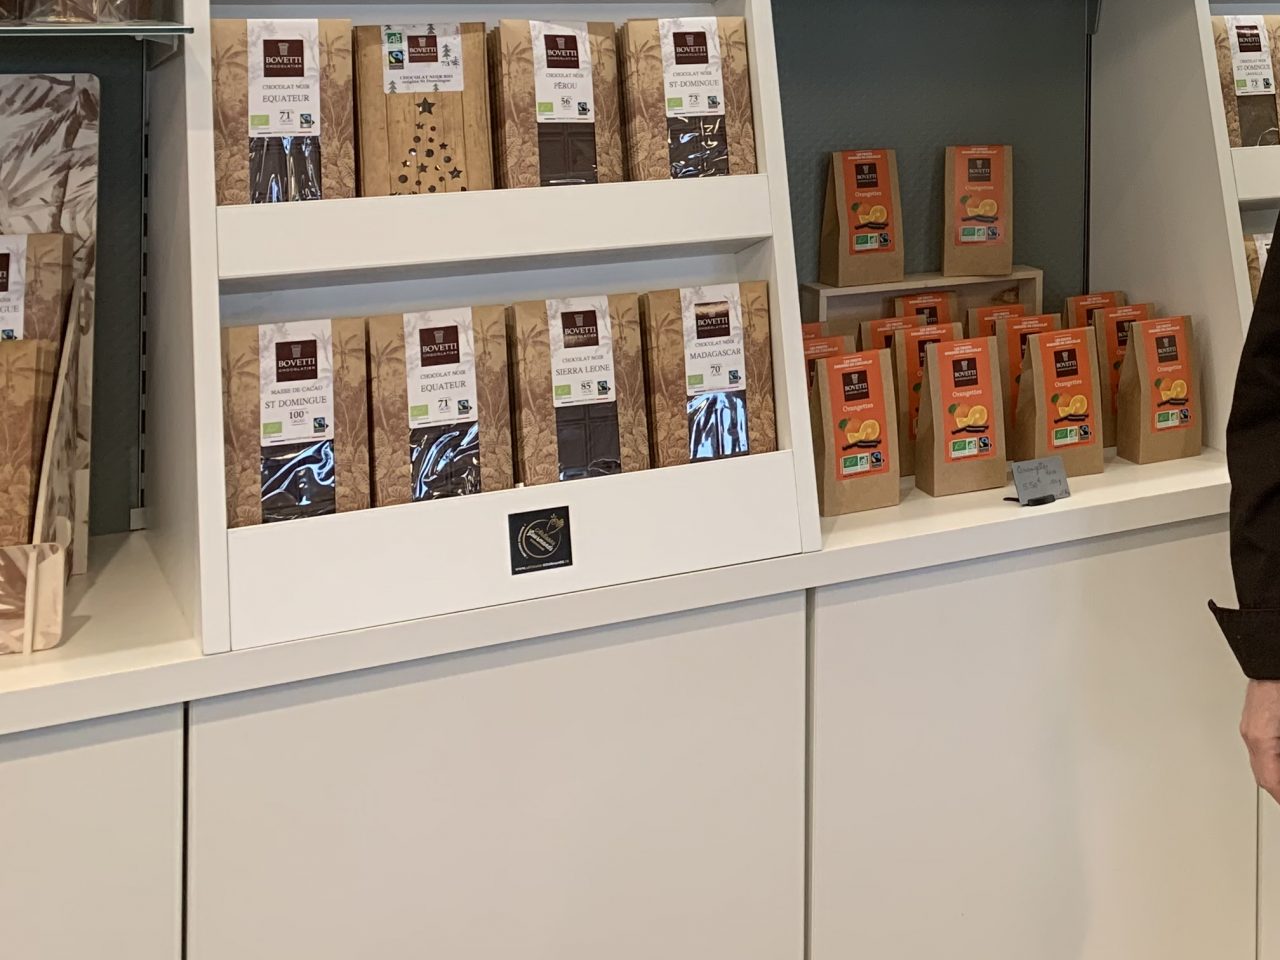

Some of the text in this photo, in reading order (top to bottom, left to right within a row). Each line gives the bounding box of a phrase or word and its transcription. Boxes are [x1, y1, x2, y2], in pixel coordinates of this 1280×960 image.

[554, 82, 577, 90] PÉROU
[669, 80, 720, 88] ST-DOMINGUE
[262, 95, 310, 103] EQUATEUR
[698, 317, 728, 326] BOVETTI
[564, 326, 596, 335] BOVETTI
[422, 343, 457, 352] BOVETTI
[690, 348, 741, 360] MADAGASCAR
[278, 358, 315, 368] BOVETTI
[1056, 360, 1077, 368] BOVETTI
[555, 364, 610, 376] SIERRA LEONE
[955, 370, 977, 378] BOVETTI
[420, 371, 451, 379] CHOCOLAT
[420, 381, 466, 392] EQUATEUR
[844, 382, 868, 391] BOVETTI
[1054, 379, 1083, 388] Orangettes
[952, 389, 983, 398] Orangettes
[265, 396, 327, 409] ST DOMINGUE
[842, 402, 874, 413] Orangettes
